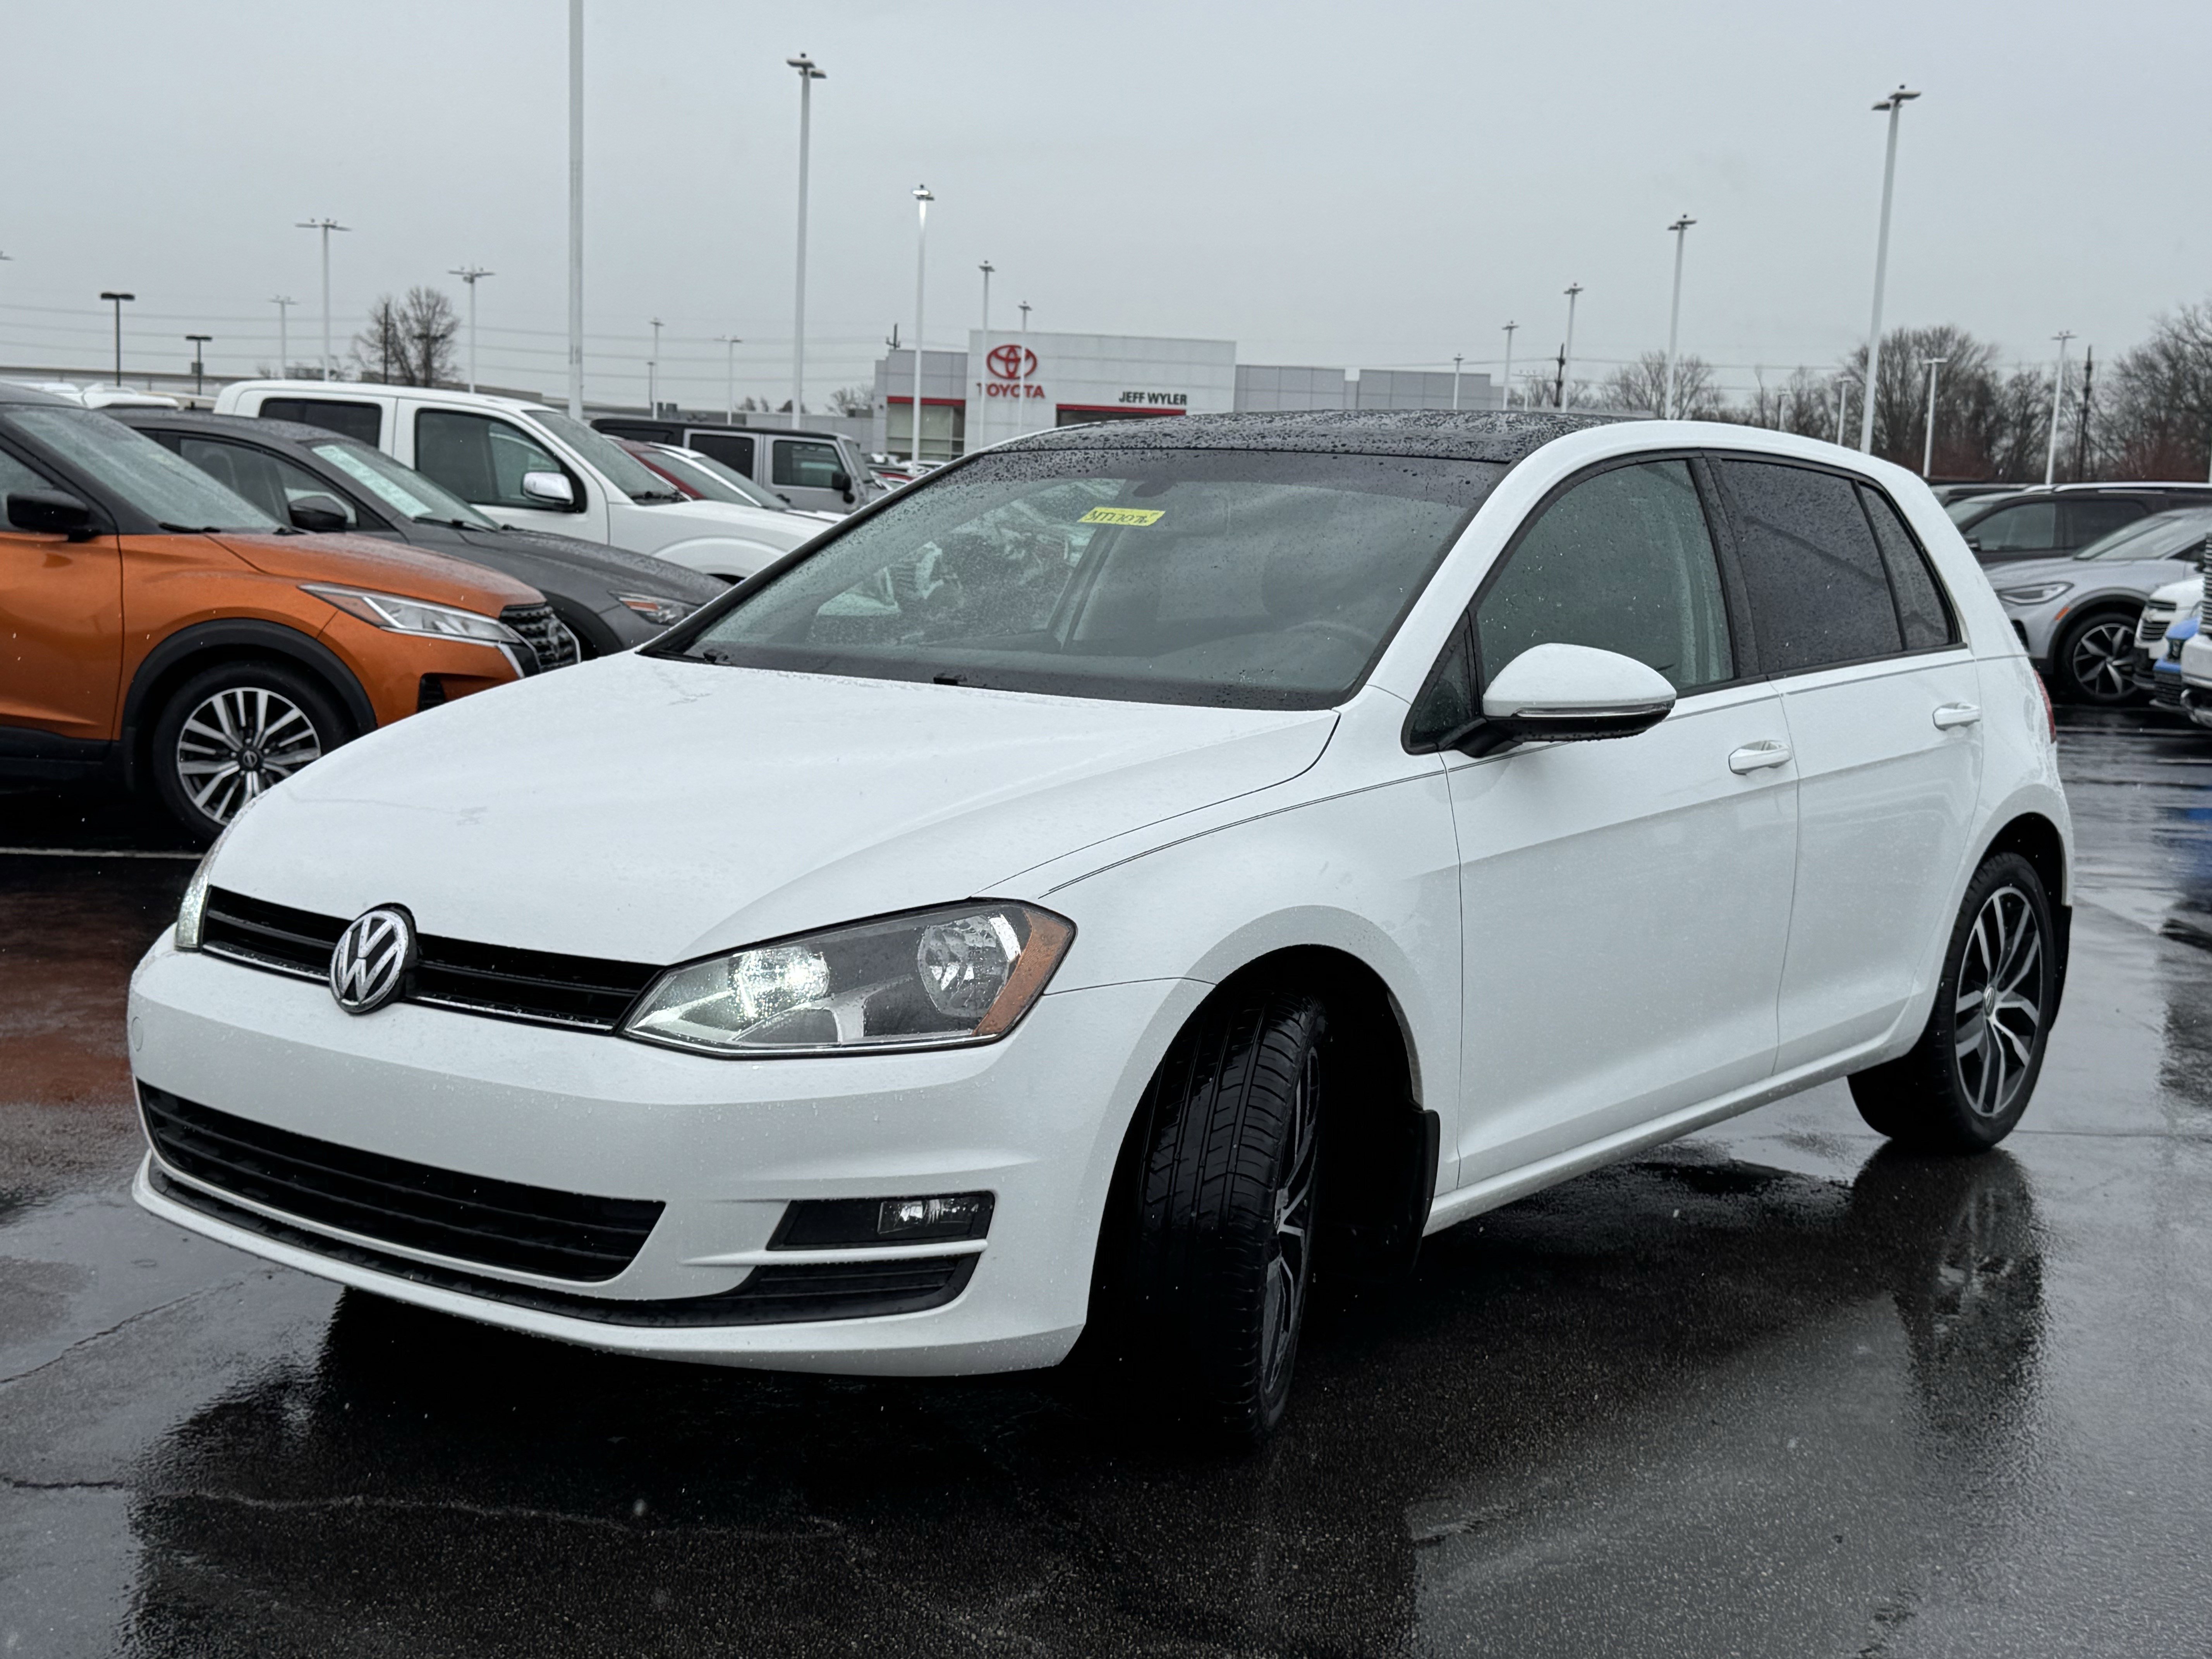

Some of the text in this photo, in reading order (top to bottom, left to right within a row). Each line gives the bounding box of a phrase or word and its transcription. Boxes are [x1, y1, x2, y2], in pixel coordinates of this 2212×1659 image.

[1119, 391, 1187, 405] JEFF WYLER
[334, 912, 405, 1005] VW
